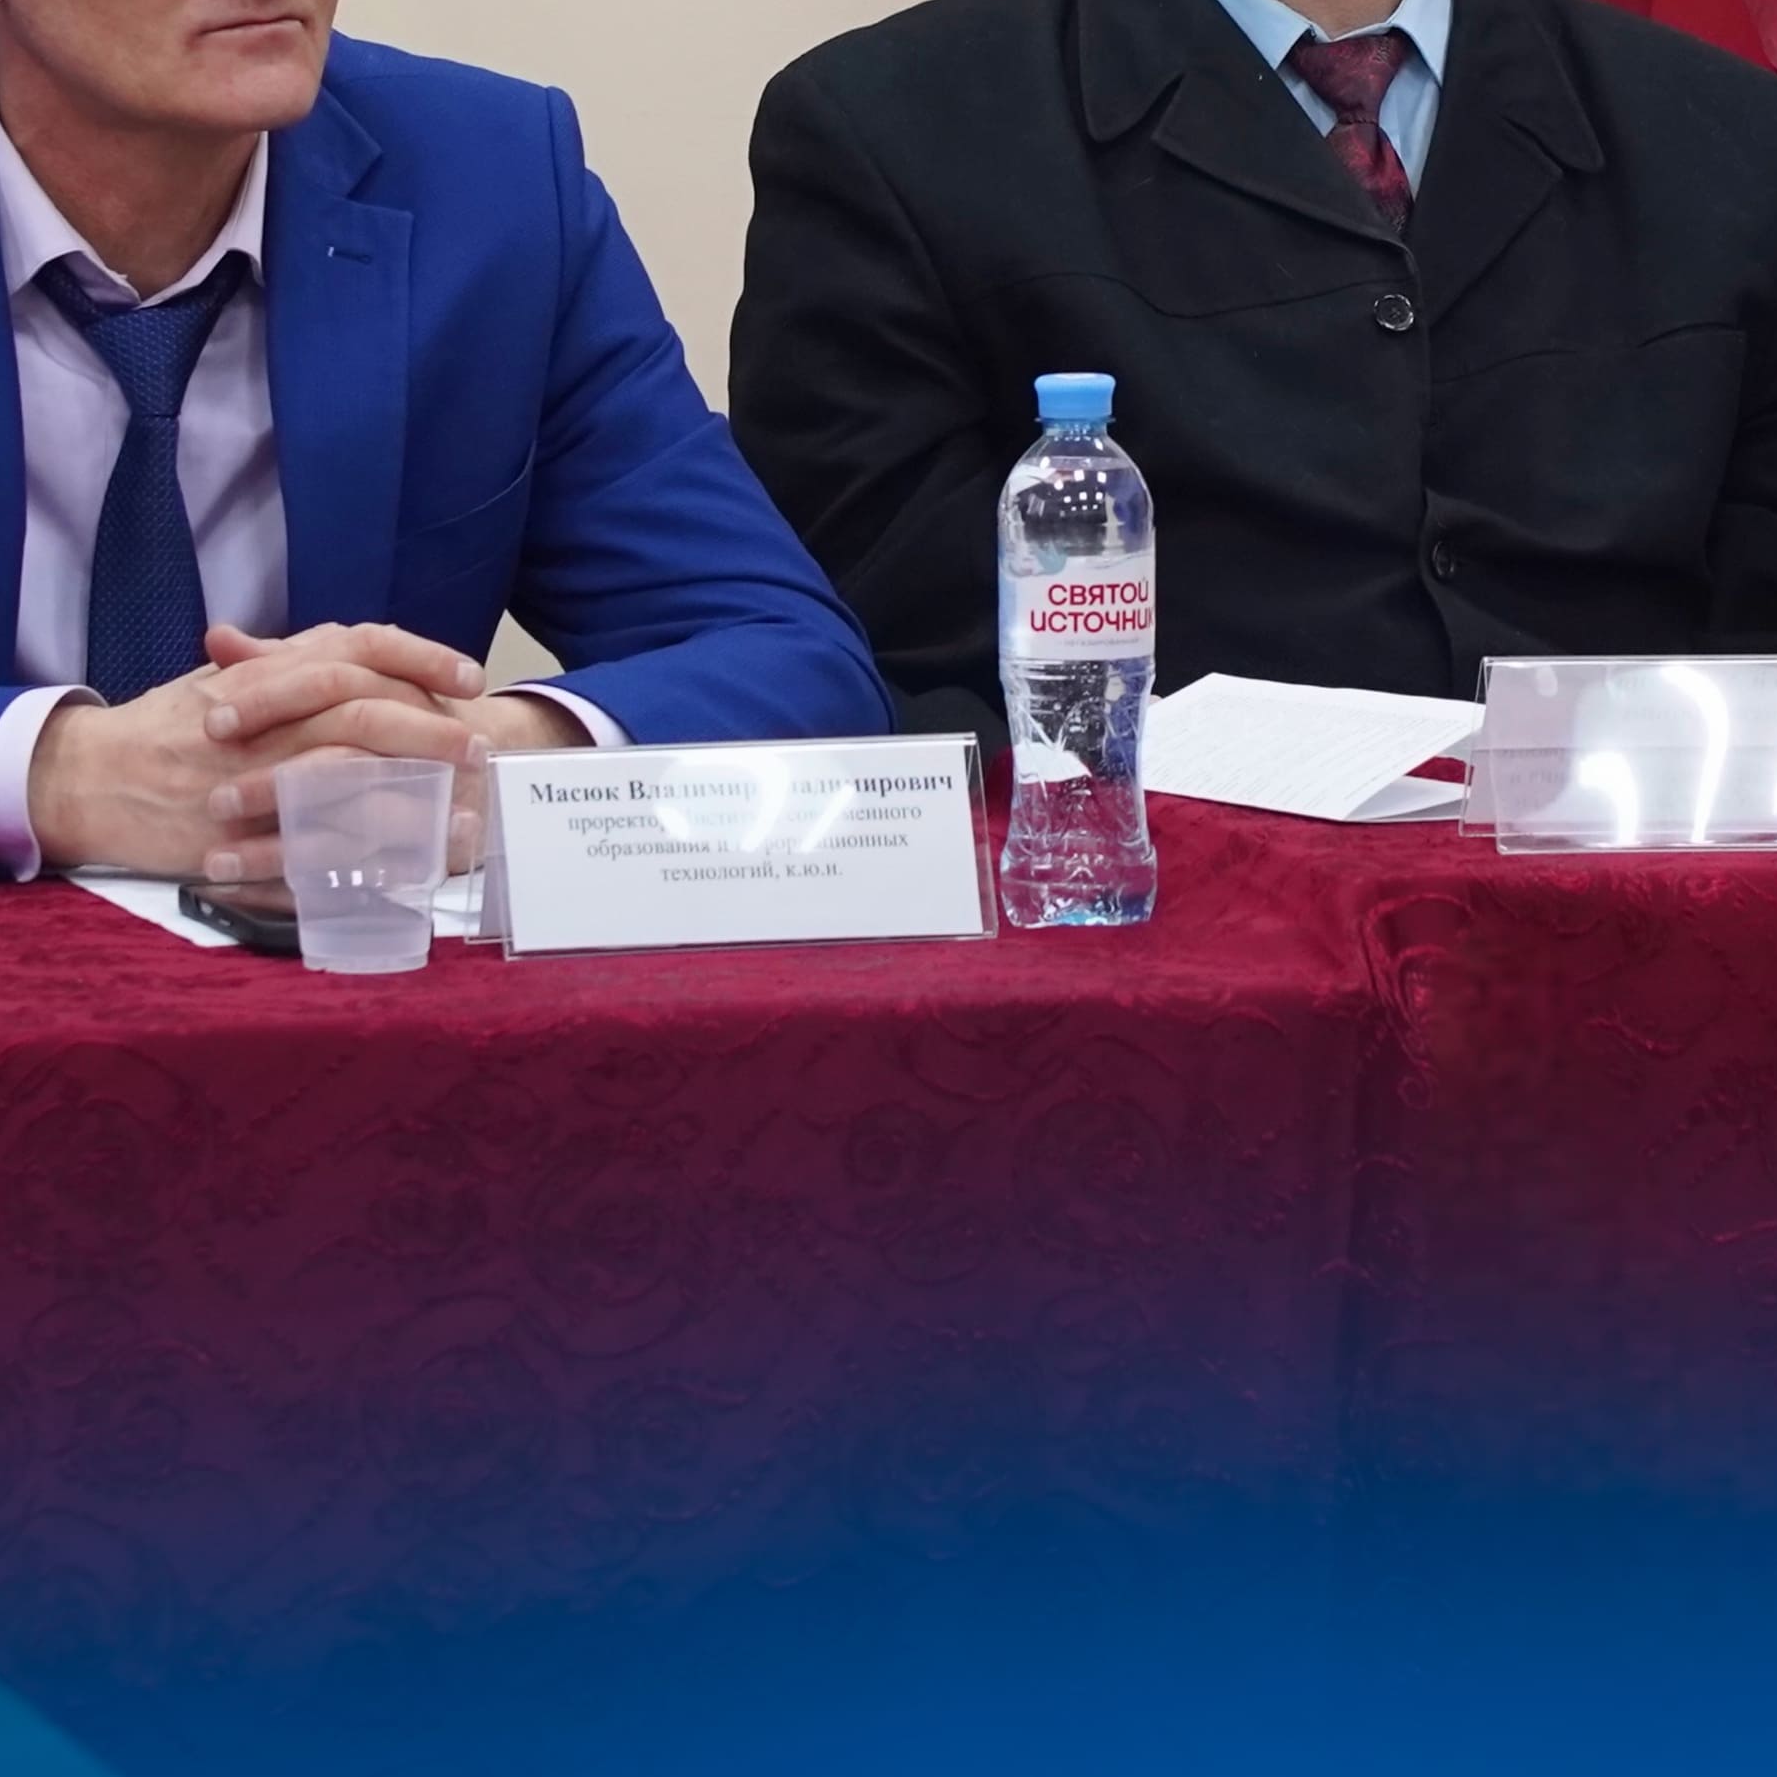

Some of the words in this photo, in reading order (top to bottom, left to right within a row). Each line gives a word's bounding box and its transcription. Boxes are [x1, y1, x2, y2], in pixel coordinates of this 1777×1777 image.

[1048, 577, 1149, 606] СВЯТОЙ
[530, 782, 620, 804] Масюк
[587, 838, 711, 860] образования
[661, 860, 780, 881] технологий,
